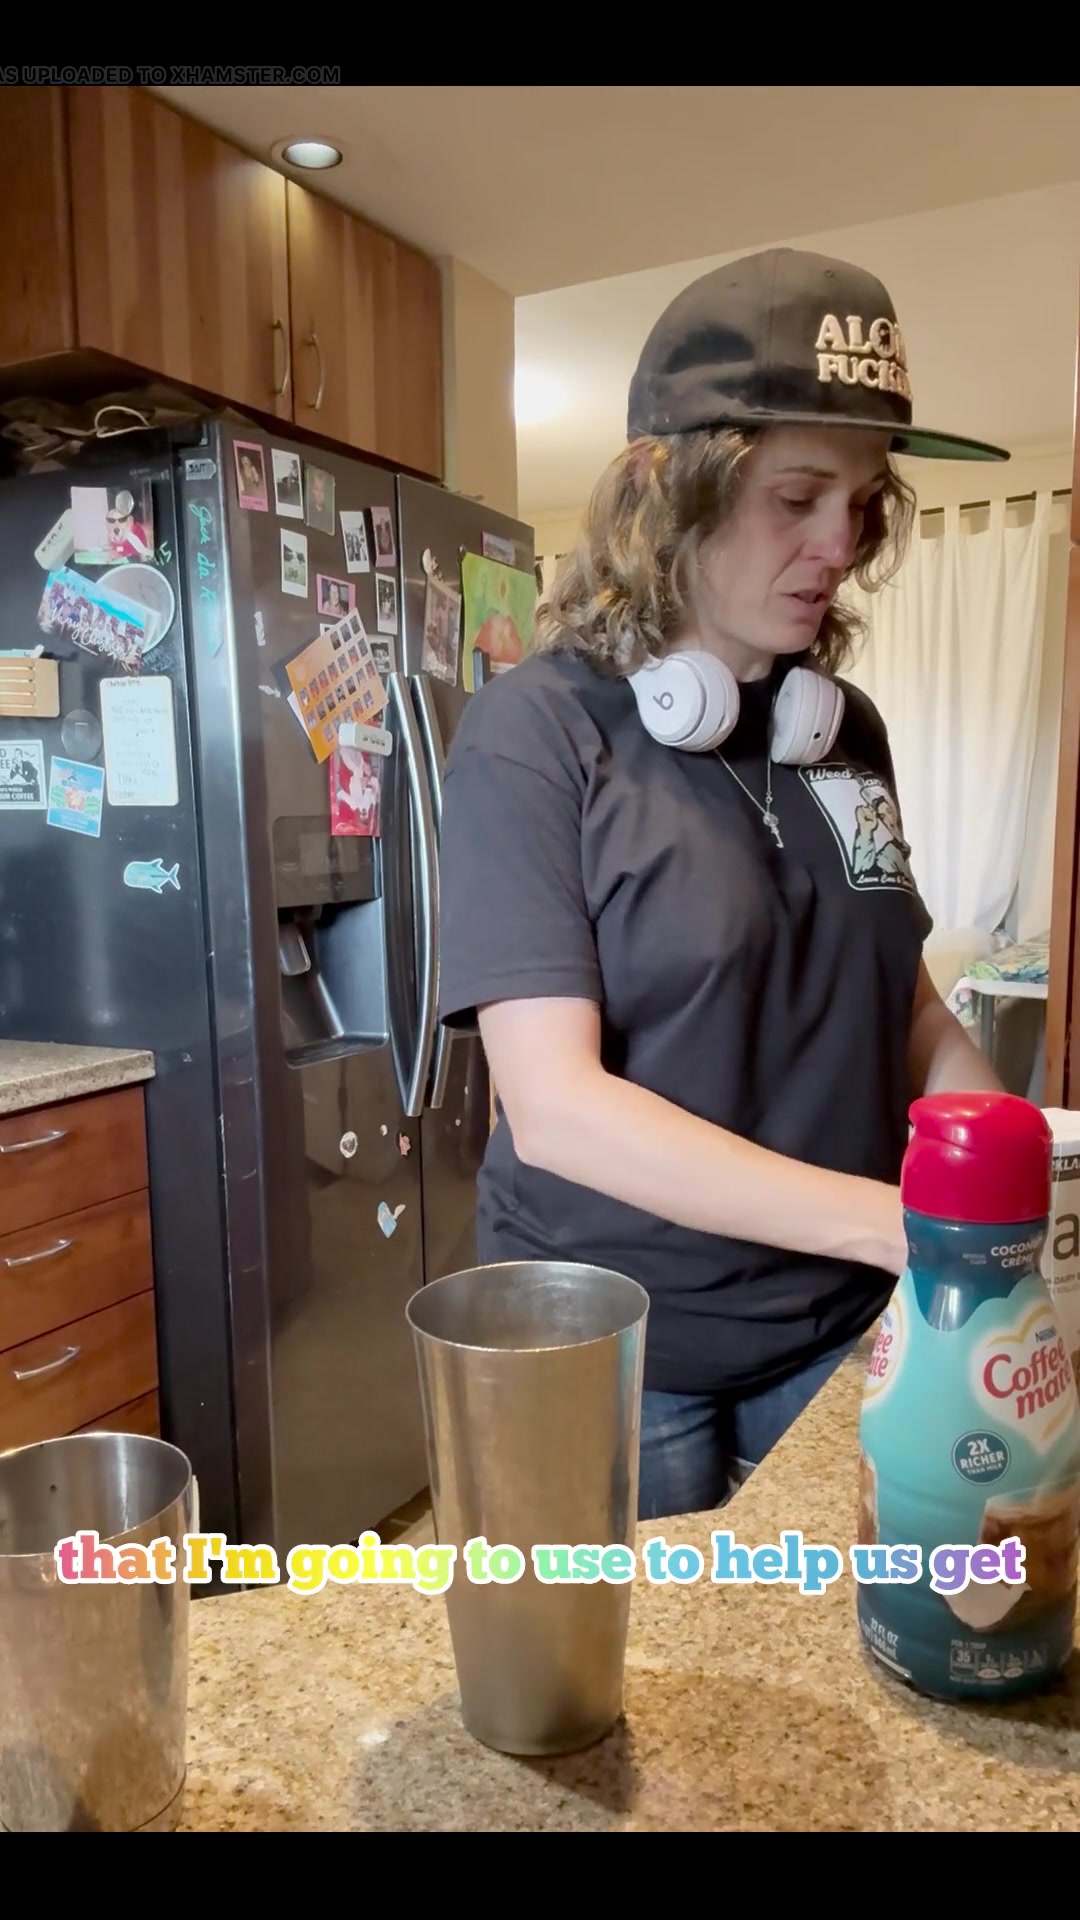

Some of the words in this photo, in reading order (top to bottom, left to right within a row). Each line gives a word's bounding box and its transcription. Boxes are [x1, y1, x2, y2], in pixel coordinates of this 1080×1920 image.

[806, 768, 853, 781] Weed
[983, 1337, 1066, 1399] Coffee
[1015, 1359, 1071, 1419] mate
[967, 1438, 990, 1456] 2X
[960, 1450, 1005, 1469] RICHER
